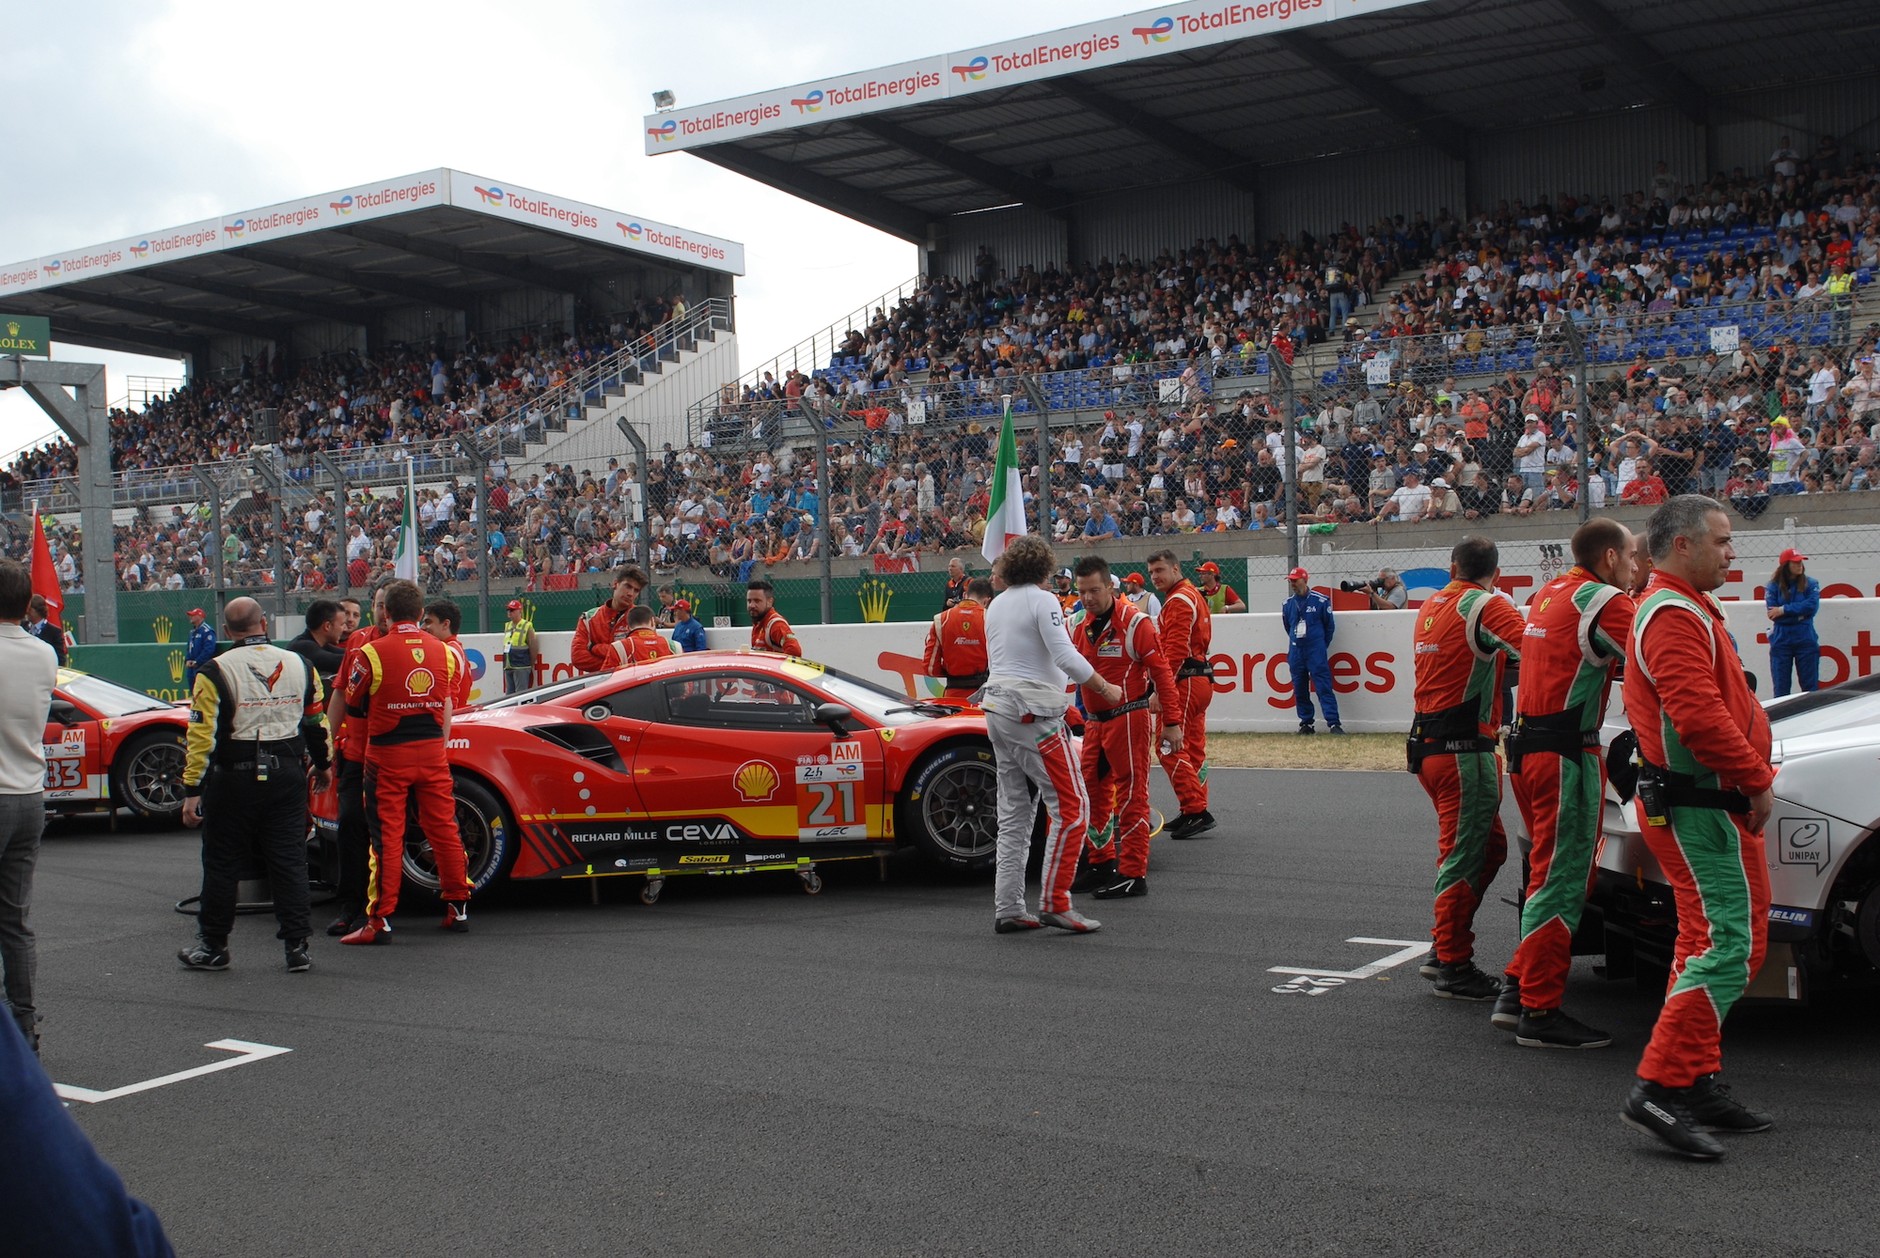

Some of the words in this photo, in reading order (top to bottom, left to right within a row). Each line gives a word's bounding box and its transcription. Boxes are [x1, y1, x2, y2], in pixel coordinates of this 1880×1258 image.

[991, 34, 1120, 73] TotalEnergies
[826, 71, 940, 106] TotalEnergies
[680, 103, 781, 136] TotalEnergies
[355, 181, 435, 210] TotalEnergies
[247, 206, 319, 233] TotalEnergies
[506, 192, 597, 228] TotalEnergies
[151, 228, 216, 254] TotalEnergies
[645, 228, 725, 260] TotalEnergies
[62, 250, 122, 273] TotalEnergies
[238, 699, 302, 709] RACING
[64, 731, 83, 743] AM
[834, 745, 860, 761] AM
[919, 752, 953, 785] MICHELIN
[806, 782, 855, 825] 21
[571, 833, 621, 842] RICHARD
[624, 831, 657, 841] MILLE
[816, 826, 850, 837] WEC
[685, 855, 724, 863] Sabelt
[763, 853, 786, 861] paoli
[1788, 851, 1821, 861] UNIPAY
